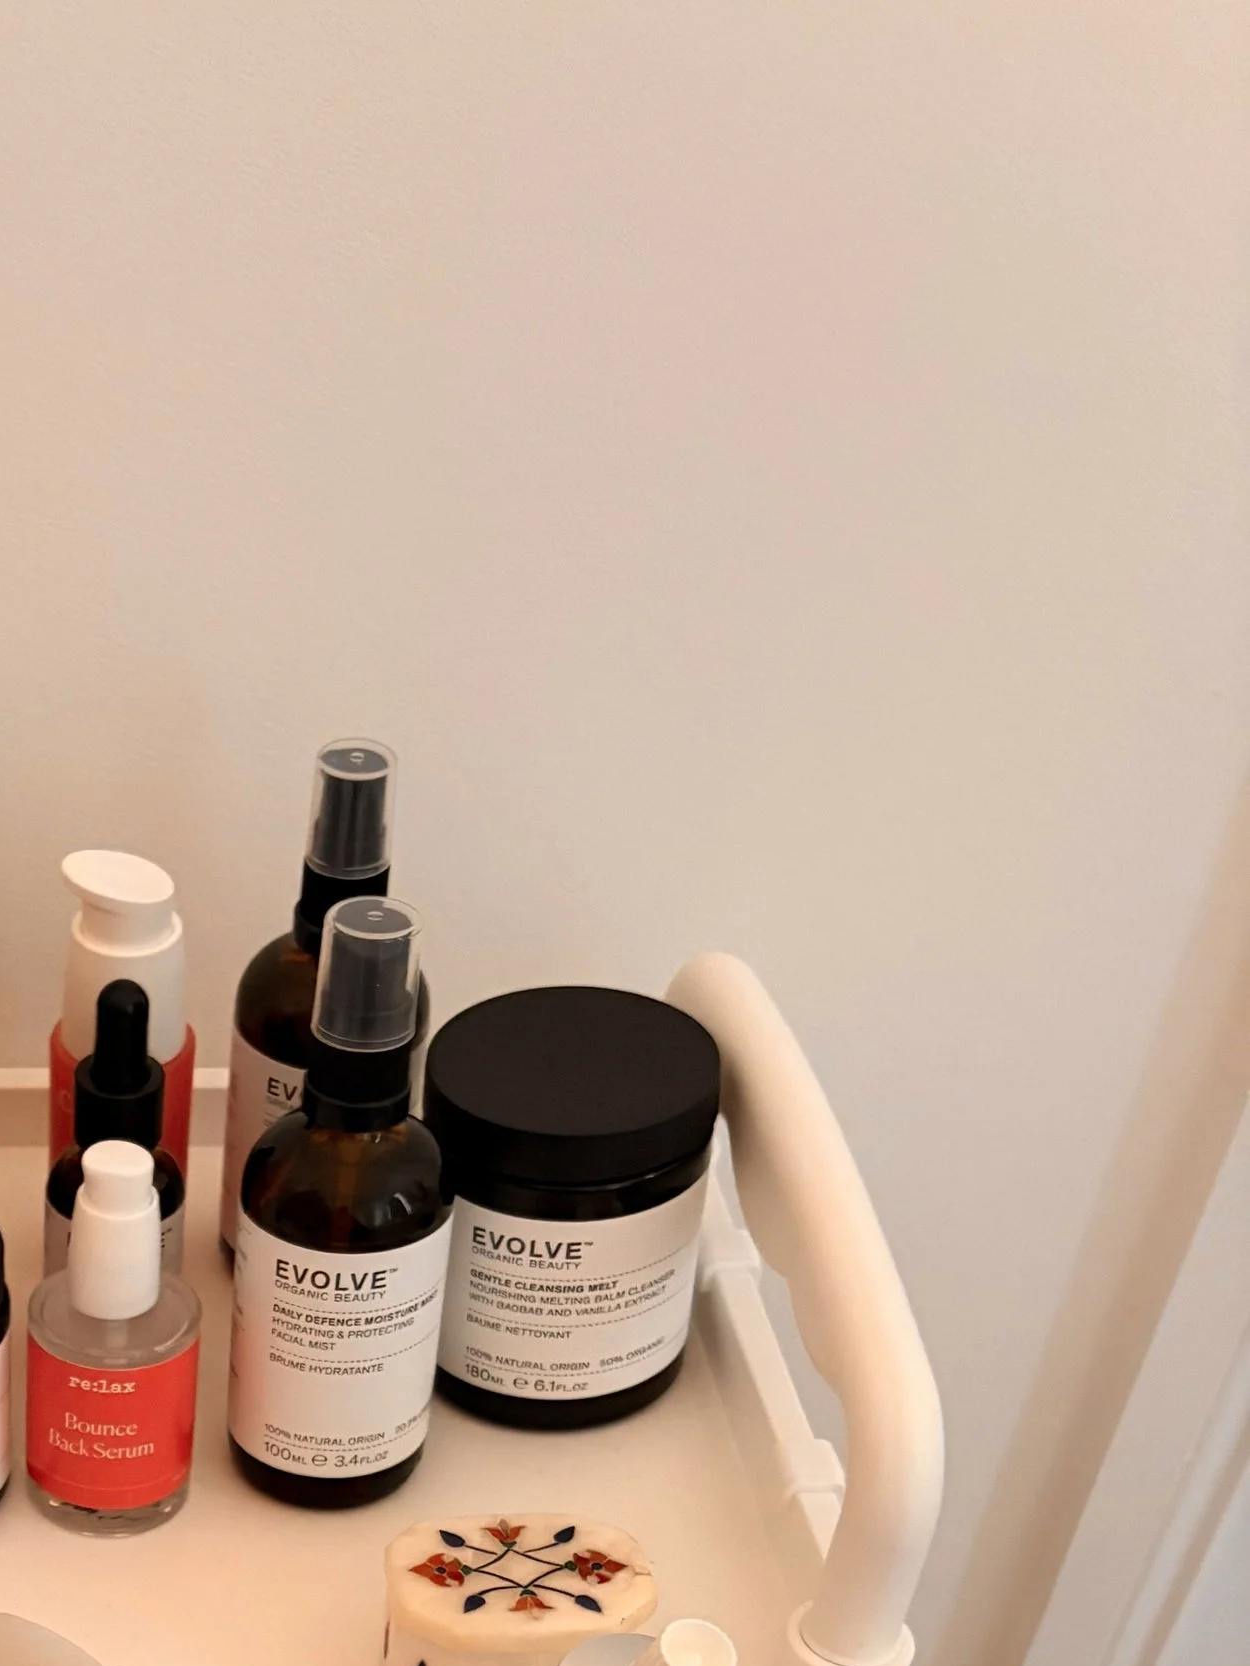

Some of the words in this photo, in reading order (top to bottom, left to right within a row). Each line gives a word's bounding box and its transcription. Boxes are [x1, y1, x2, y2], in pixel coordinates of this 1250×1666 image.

[471, 1245, 524, 1267] ORGANIC
[529, 1258, 582, 1271] BEAUTY
[274, 1279, 329, 1302] ORGANIC
[334, 1290, 386, 1303] BEAUTY
[469, 1280, 537, 1304] NOURISHING
[539, 1295, 591, 1305] MELTING
[594, 1290, 626, 1304] BALM
[470, 1267, 512, 1288] GENTLE
[514, 1280, 584, 1294] CLEANSING
[588, 1280, 619, 1293] MELT
[272, 1303, 303, 1321] DAILY
[305, 1313, 362, 1327] DEFENCE
[364, 1303, 419, 1326] MOISTURE
[468, 1291, 494, 1308] WITH
[496, 1301, 544, 1316] BAOBAB
[547, 1307, 572, 1318] AND
[575, 1302, 622, 1317] VANILLA
[271, 1315, 335, 1339] HYDRATING
[337, 1330, 345, 1340] &
[347, 1316, 415, 1339] PROTECTING
[466, 1313, 502, 1332] BAUME
[505, 1326, 573, 1340] NETTOYANT
[270, 1328, 306, 1347] FACIAL
[308, 1340, 337, 1351] MIST
[269, 1353, 306, 1372] BRUME
[308, 1363, 385, 1376] HYDRATANTE
[495, 1355, 546, 1371] NATURAL
[550, 1361, 591, 1372] ORIGIN
[68, 1376, 136, 1393] re:lax
[64, 1411, 138, 1437] Bounce
[48, 1427, 89, 1457] Back
[93, 1441, 155, 1460] Serum
[293, 1433, 346, 1447] NATURAL
[347, 1432, 386, 1446] ORIGIN
[264, 1441, 307, 1466] 100ML
